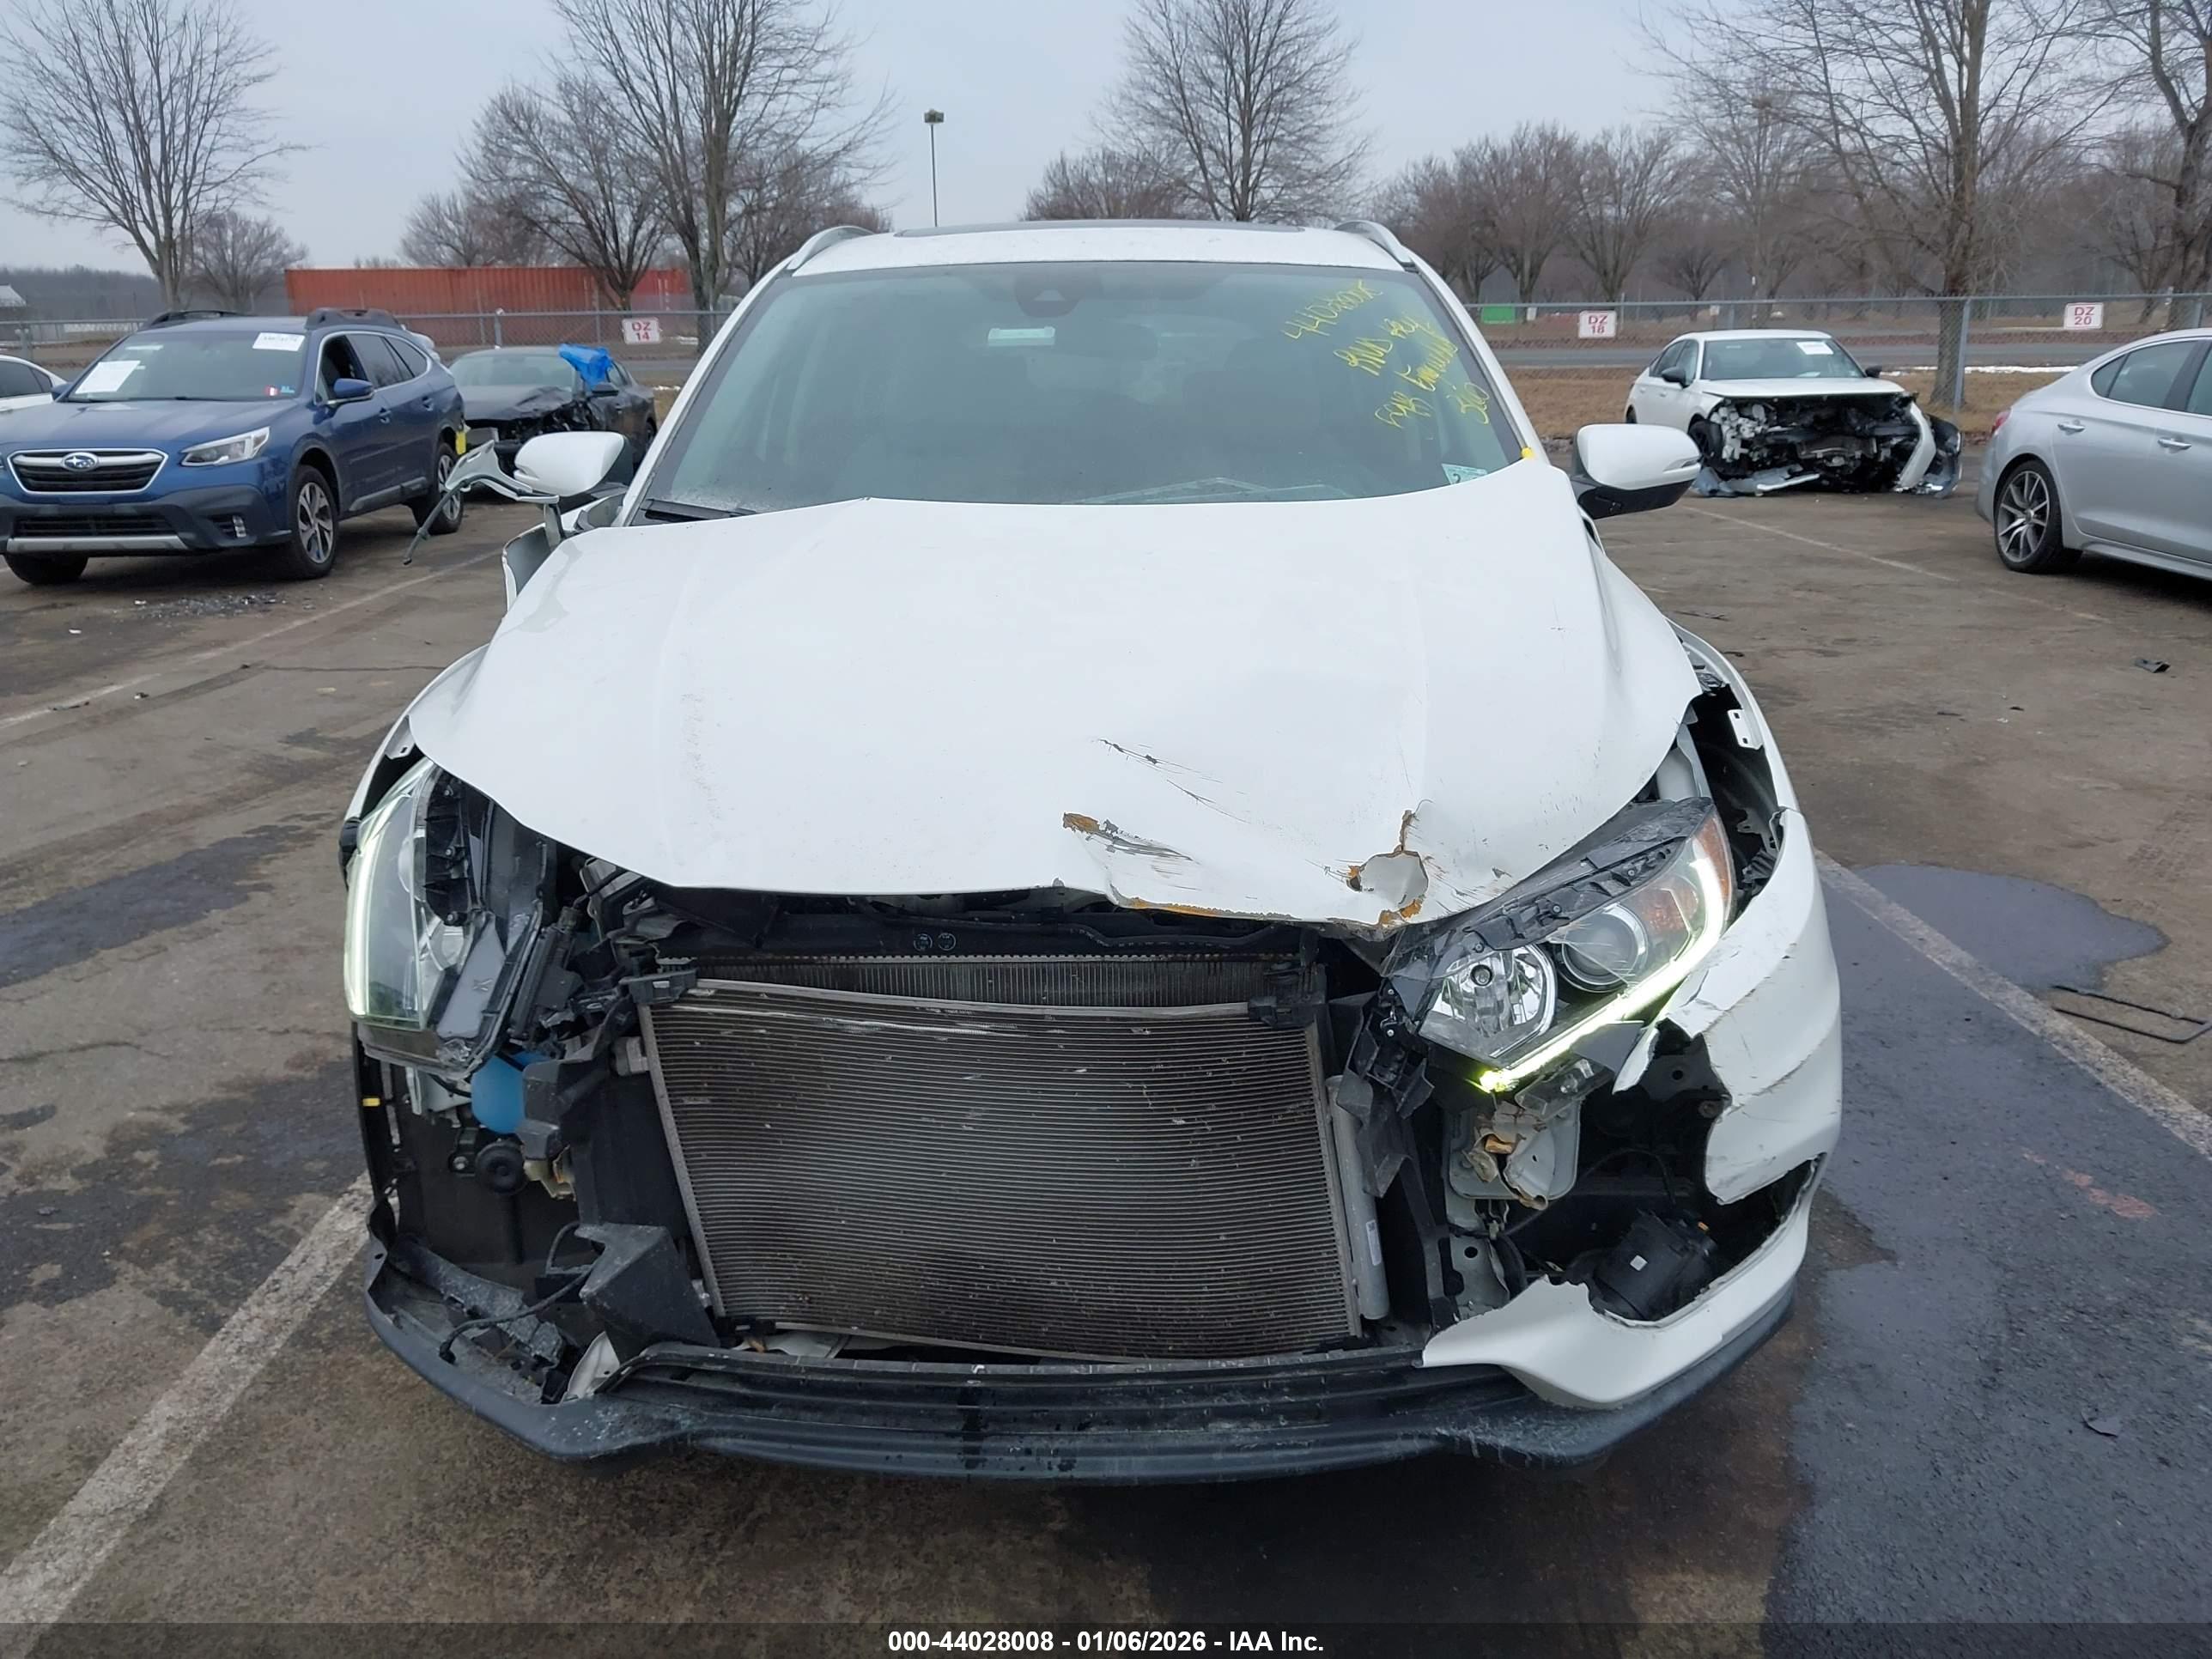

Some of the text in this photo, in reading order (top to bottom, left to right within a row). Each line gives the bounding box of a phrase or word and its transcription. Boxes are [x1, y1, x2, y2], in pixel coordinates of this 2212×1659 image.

[2074, 306, 2096, 316] DZ
[1589, 315, 1608, 325] DZ
[2074, 316, 2092, 325] 20
[631, 321, 652, 331] DZ
[1592, 325, 1605, 334] 18
[635, 331, 650, 341] 14
